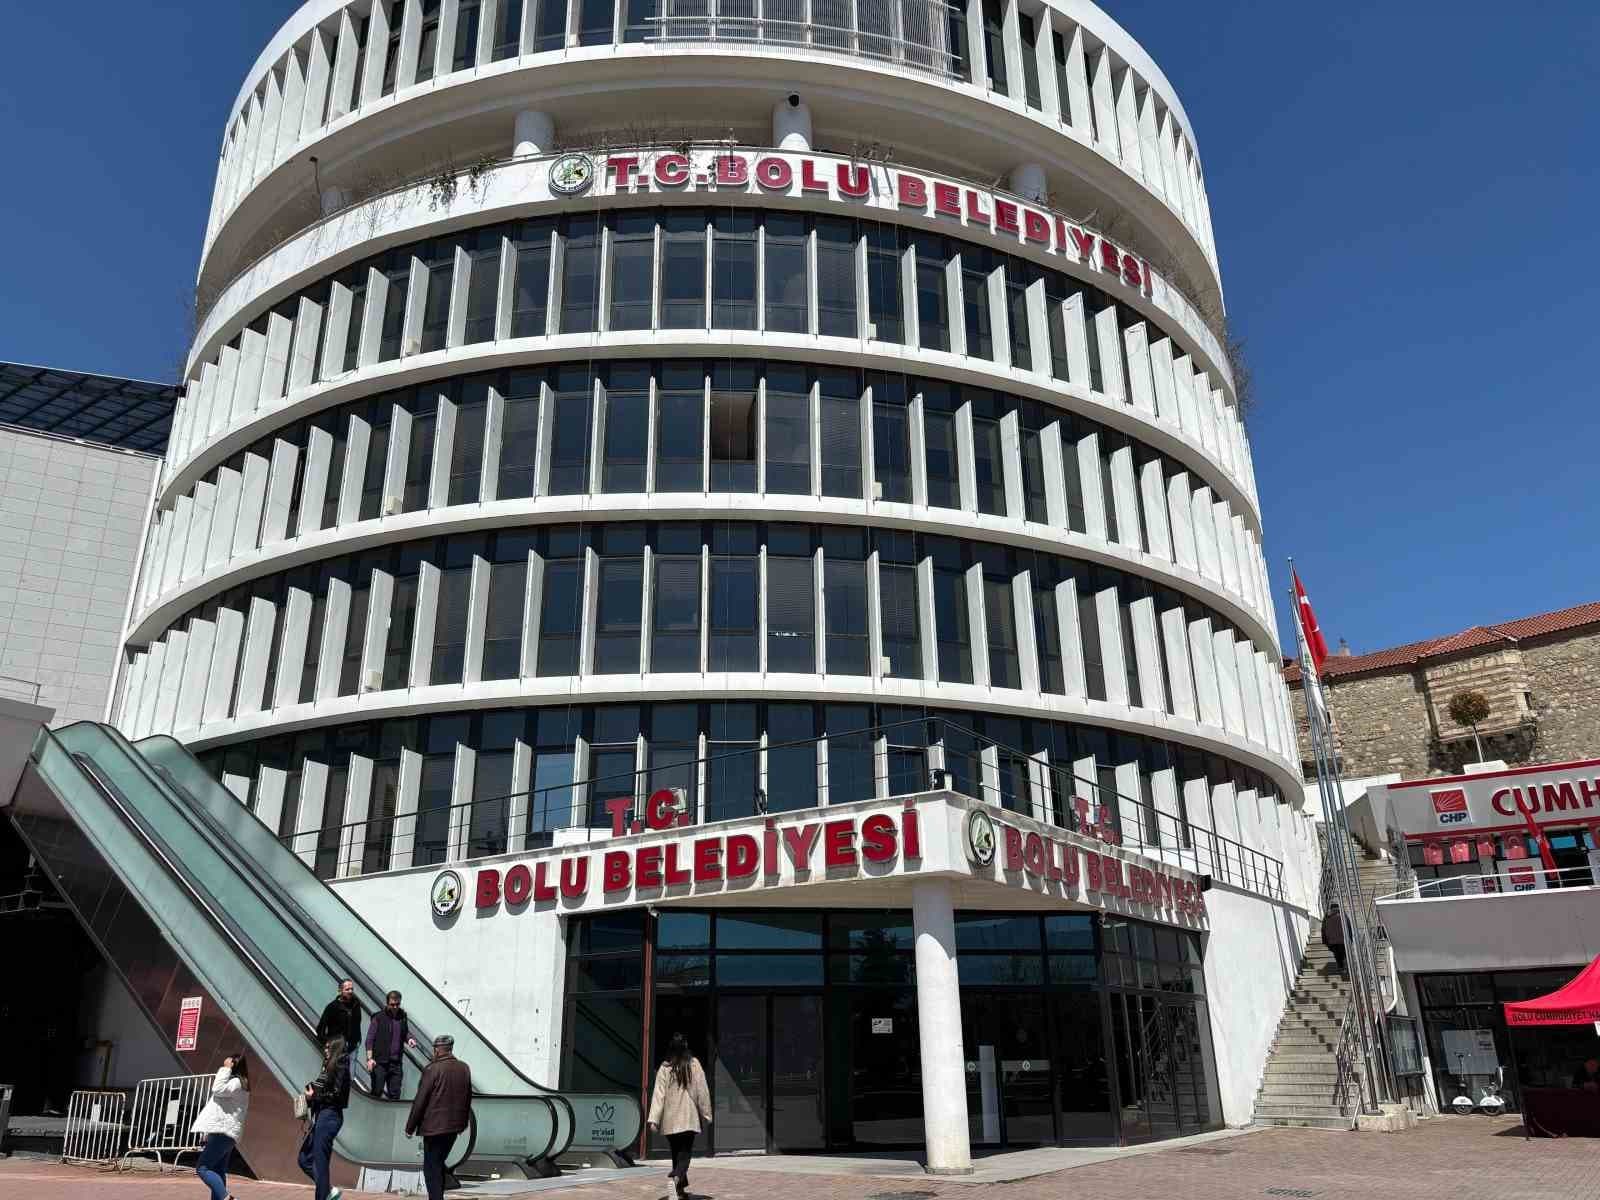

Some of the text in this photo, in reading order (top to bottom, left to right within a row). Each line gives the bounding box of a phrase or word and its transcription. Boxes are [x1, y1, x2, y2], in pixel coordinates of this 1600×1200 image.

[898, 174, 1153, 297] BELEDİYESİ
[605, 788, 689, 837] T.C.
[1439, 812, 1468, 824] CHP
[476, 801, 920, 907] BOLU BELEDİYESİ
[1006, 826, 1080, 888] BOLU
[1514, 883, 1536, 892] CHP
